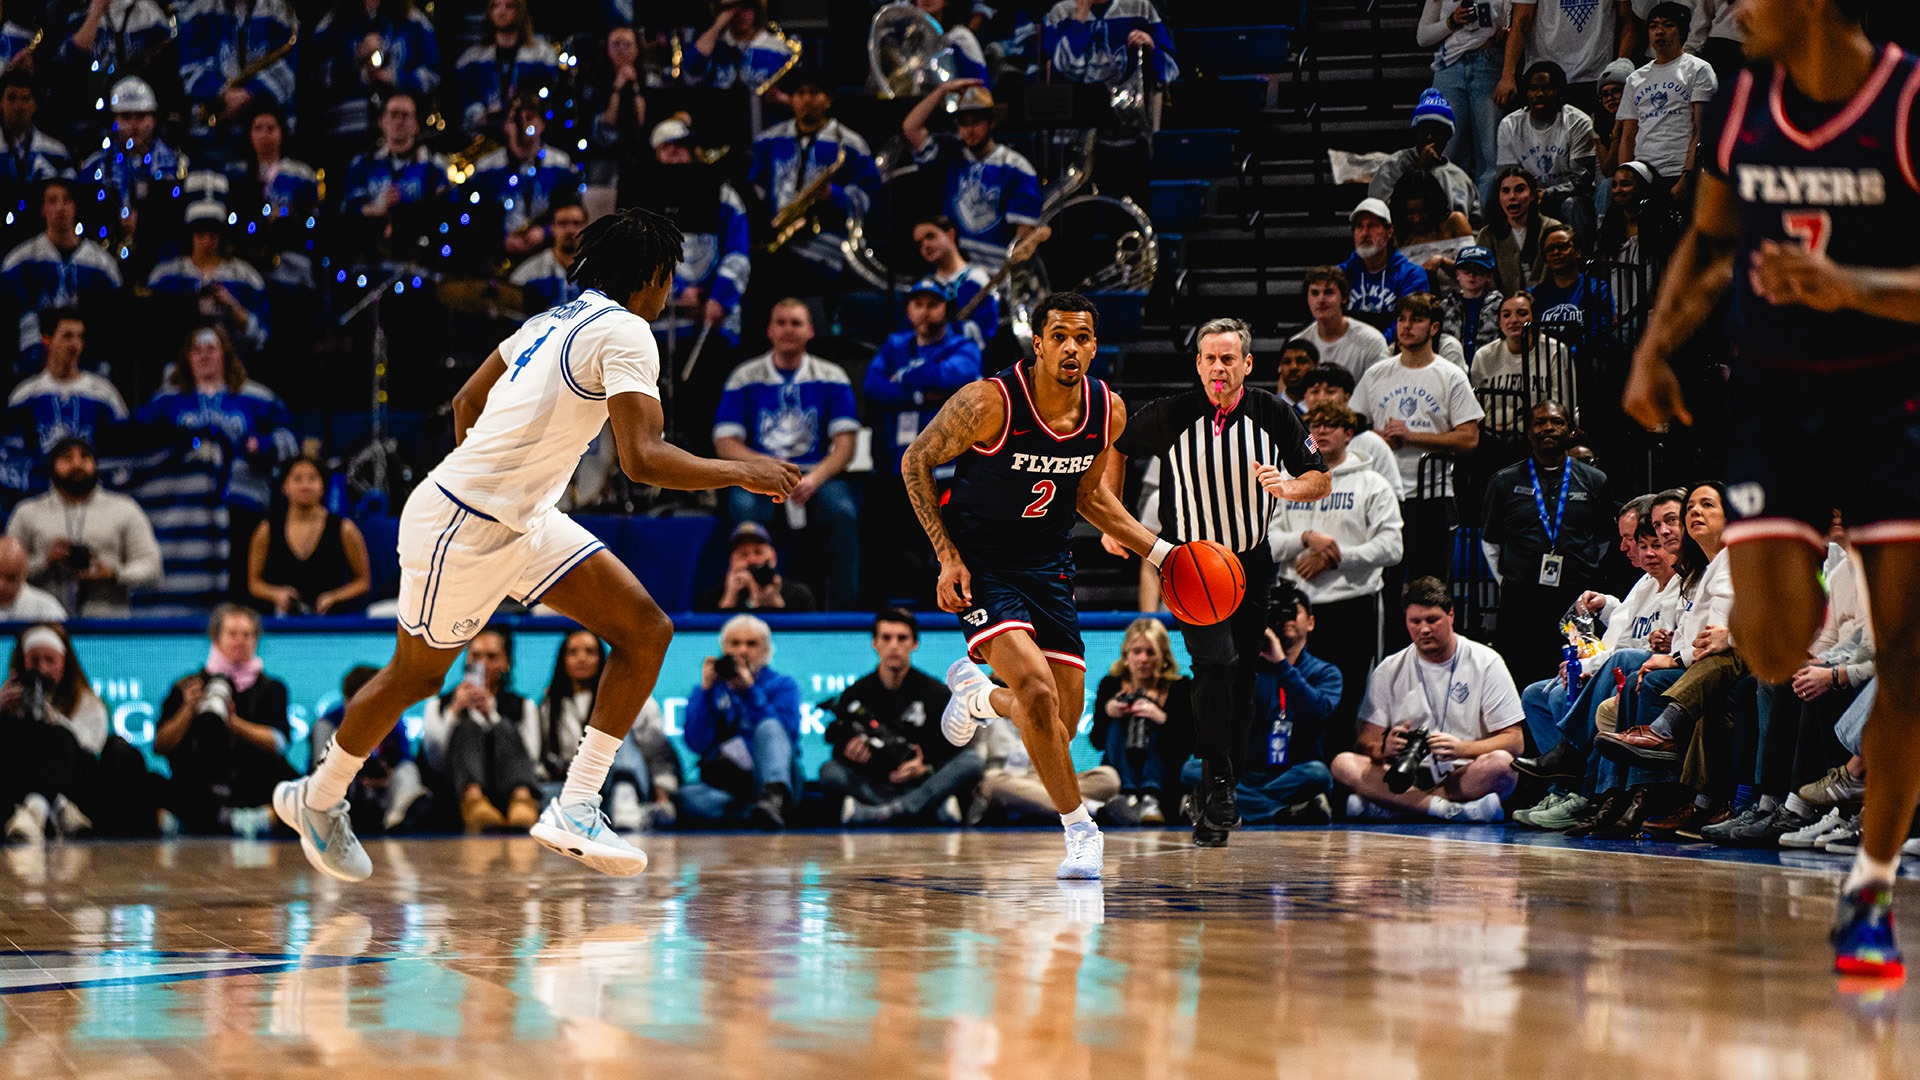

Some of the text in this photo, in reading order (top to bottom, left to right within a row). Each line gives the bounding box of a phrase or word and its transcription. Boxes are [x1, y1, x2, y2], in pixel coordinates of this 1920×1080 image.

[1736, 163, 1886, 206] FLYERS
[1782, 209, 1832, 255] 7
[510, 326, 557, 382] 4
[1379, 386, 1440, 414] SAINT LOUIS
[1011, 452, 1094, 474] FLYERS
[1021, 479, 1057, 518] 2
